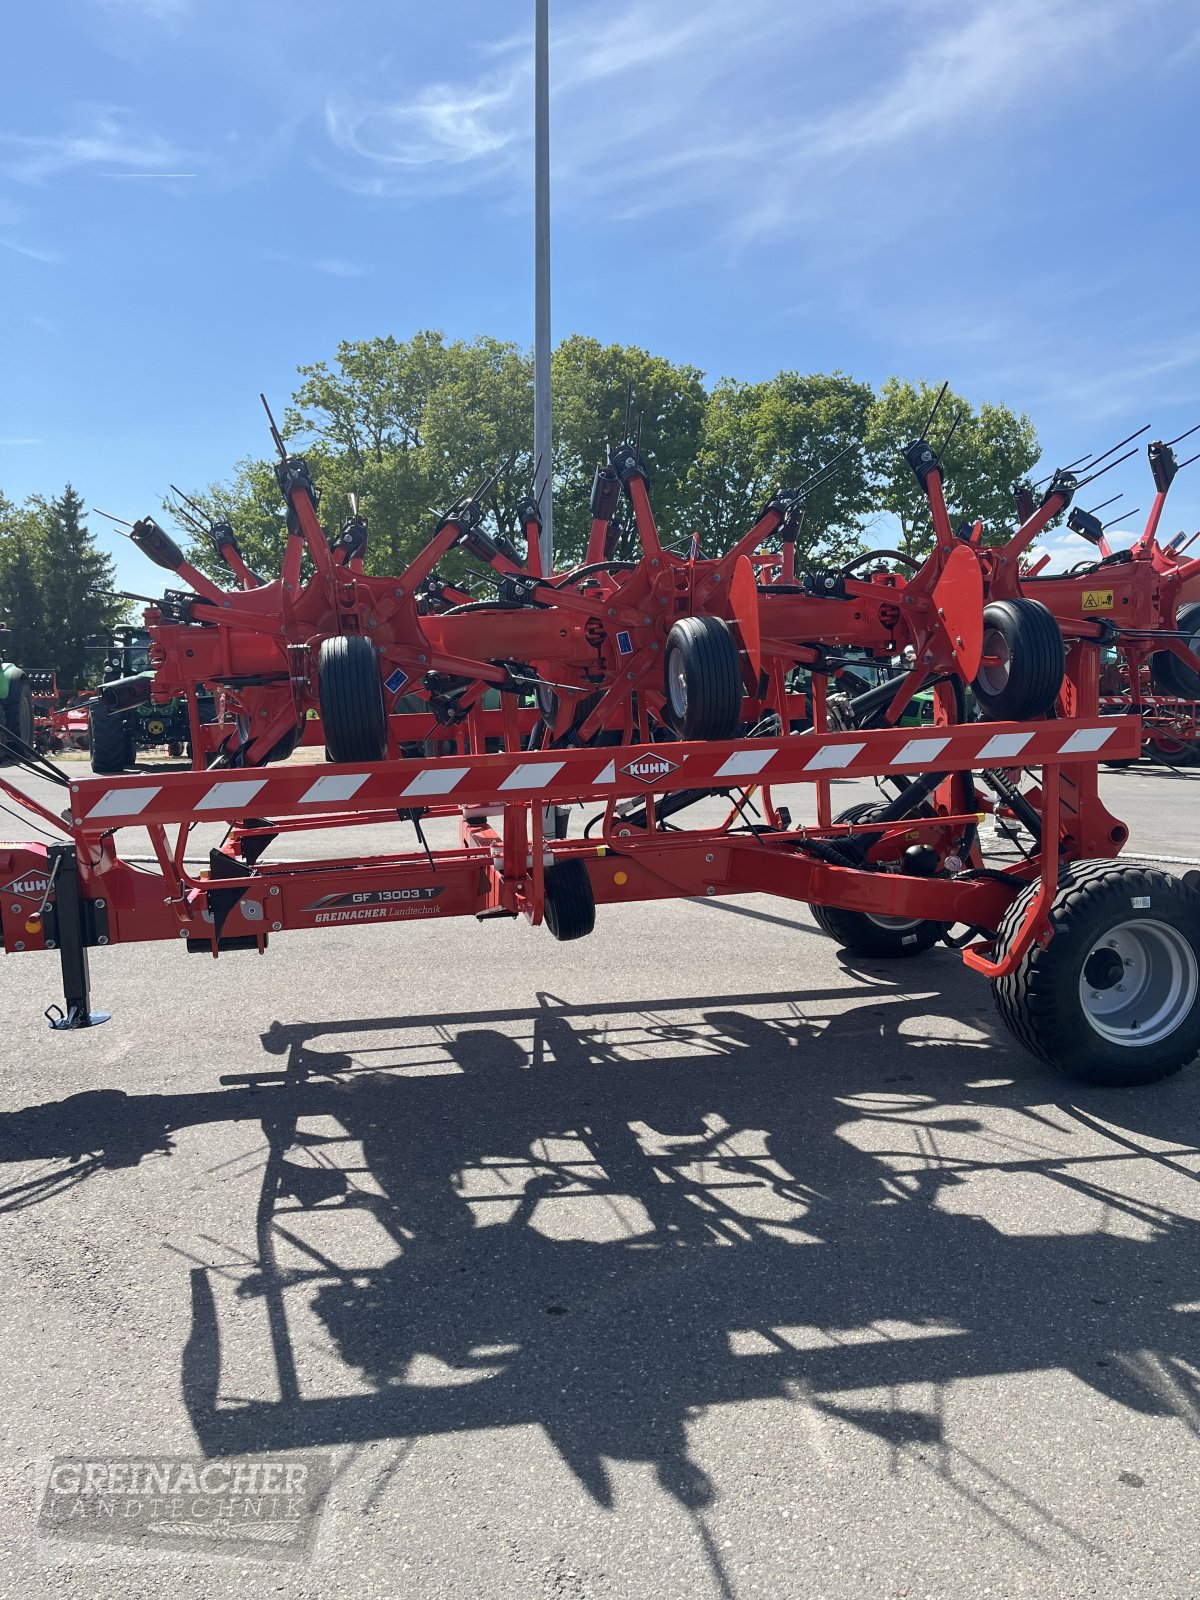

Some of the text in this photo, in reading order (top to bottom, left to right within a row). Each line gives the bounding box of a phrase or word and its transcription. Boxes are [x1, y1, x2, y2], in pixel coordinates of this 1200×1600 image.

[630, 762, 670, 775] KUHN
[352, 888, 435, 903] GF 13003 T
[315, 905, 441, 922] GREINACHER Landtechnik
